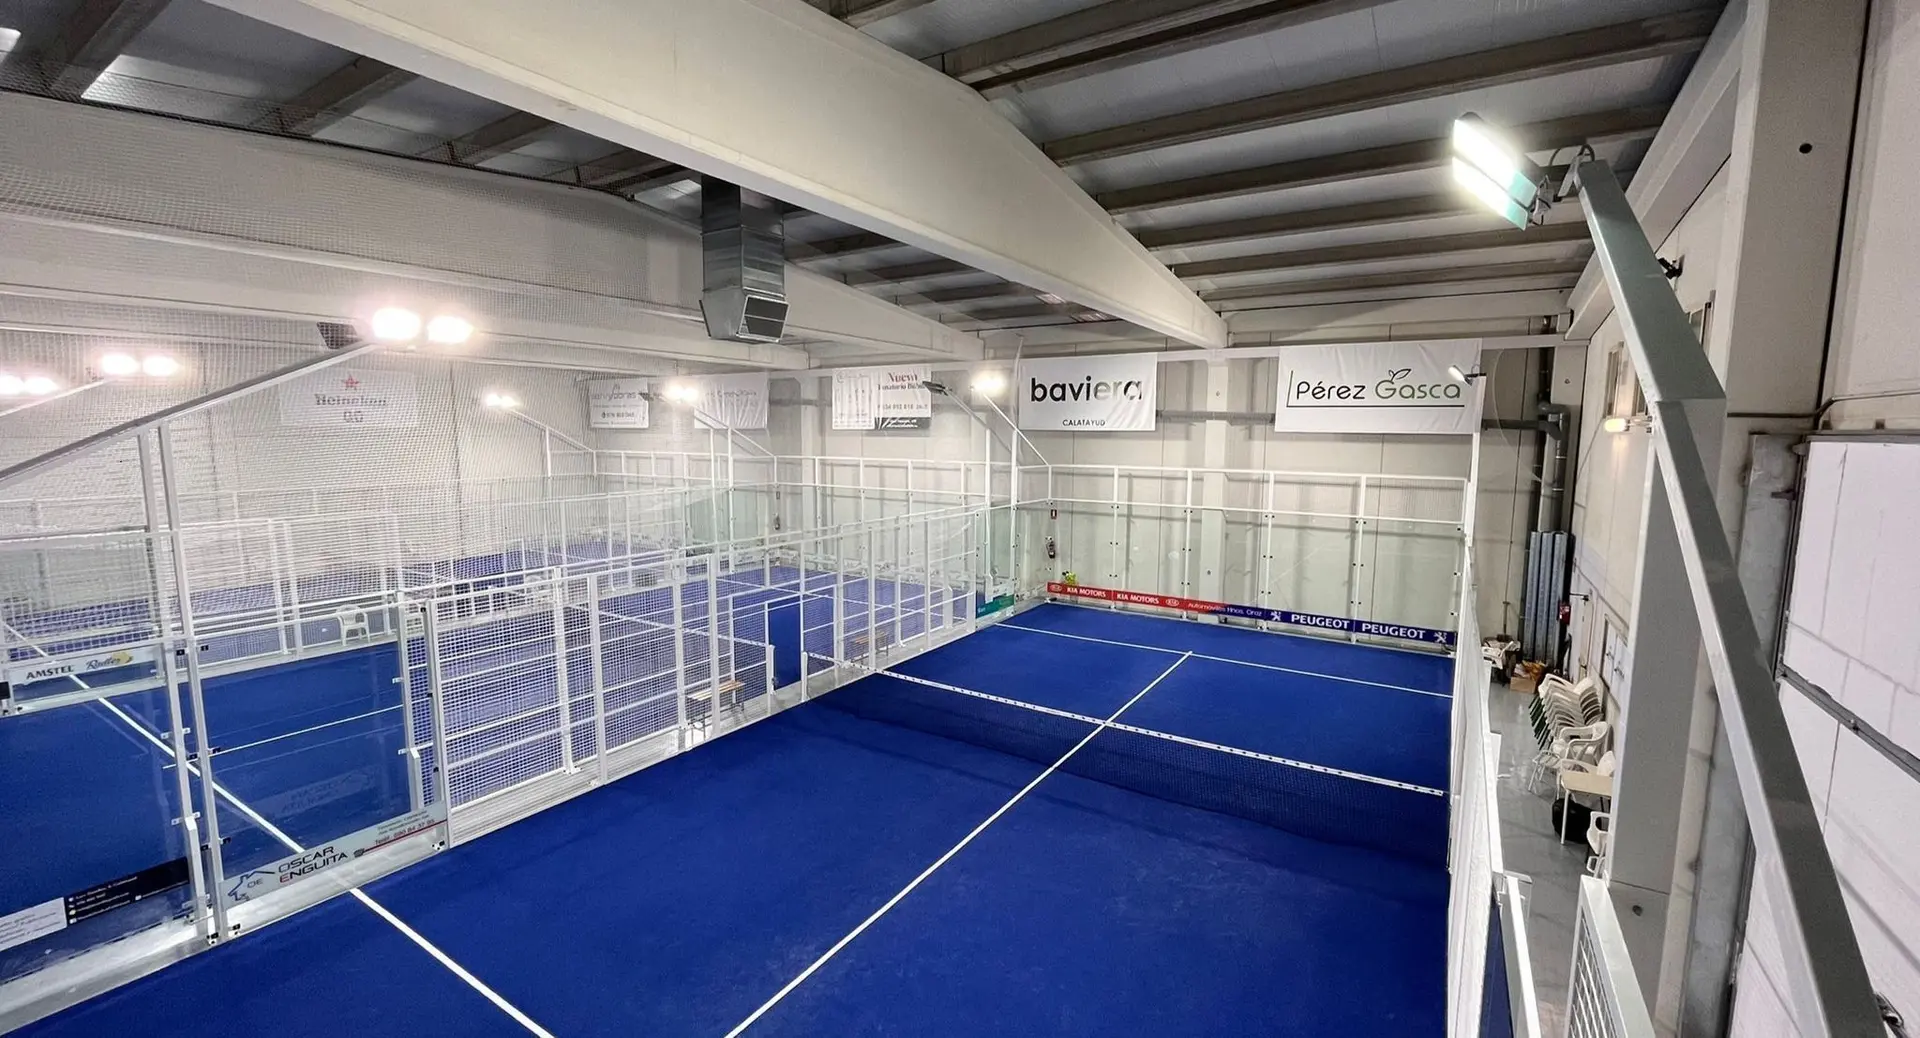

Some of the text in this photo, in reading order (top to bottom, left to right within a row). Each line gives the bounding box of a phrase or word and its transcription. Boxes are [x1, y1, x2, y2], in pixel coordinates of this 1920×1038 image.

[1030, 375, 1142, 402] baviera
[1296, 379, 1461, 400] Pérez Gasca
[1062, 419, 1106, 427] CALATAYUD
[1066, 586, 1106, 598] KIA MOTORS
[1116, 593, 1160, 605] KIA MOTORS
[1291, 614, 1349, 629] PEUGEOT
[1362, 623, 1425, 639] PEUGEOT
[26, 665, 75, 680] AMSTEL
[278, 846, 335, 873] OSCAR
[280, 852, 349, 883] ENGUITA
